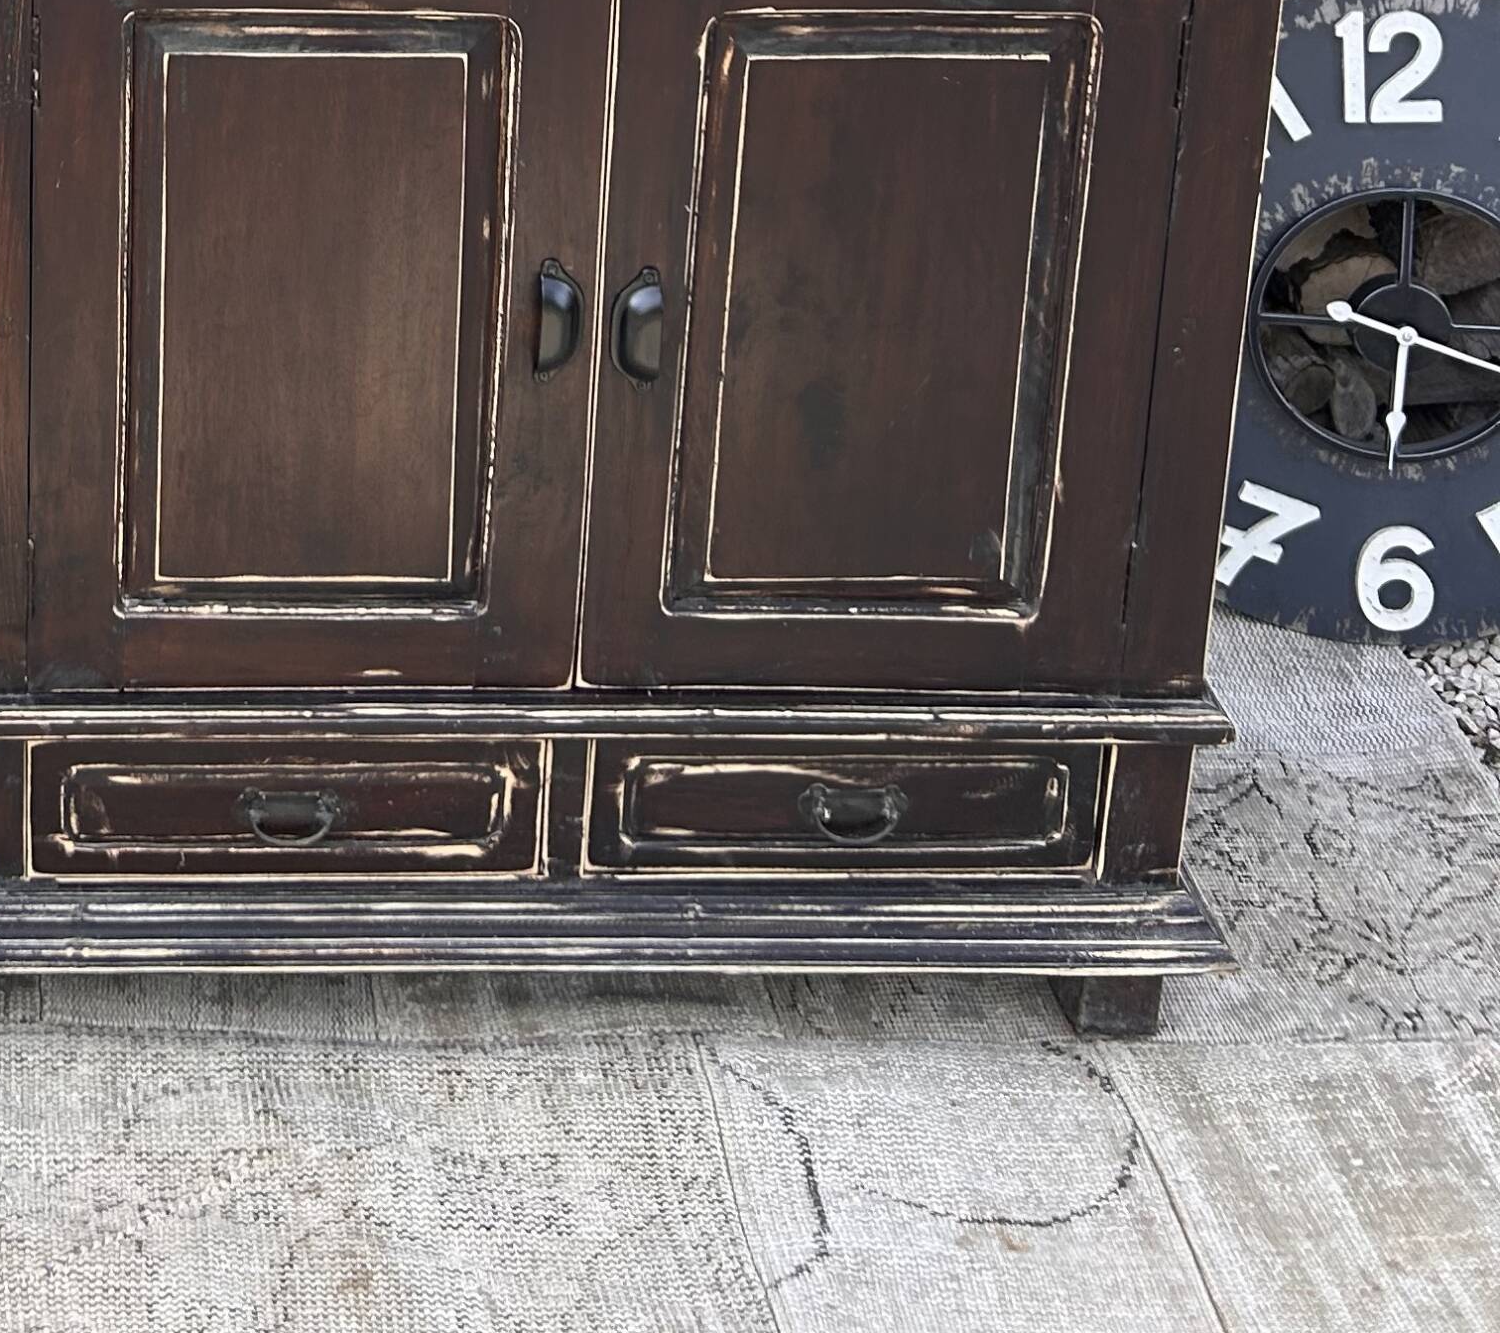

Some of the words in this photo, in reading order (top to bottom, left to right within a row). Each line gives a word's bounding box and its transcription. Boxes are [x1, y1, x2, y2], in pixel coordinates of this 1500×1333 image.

[1334, 10, 1444, 124] 12
[1214, 480, 1321, 586] 7
[1356, 525, 1436, 632] 6
